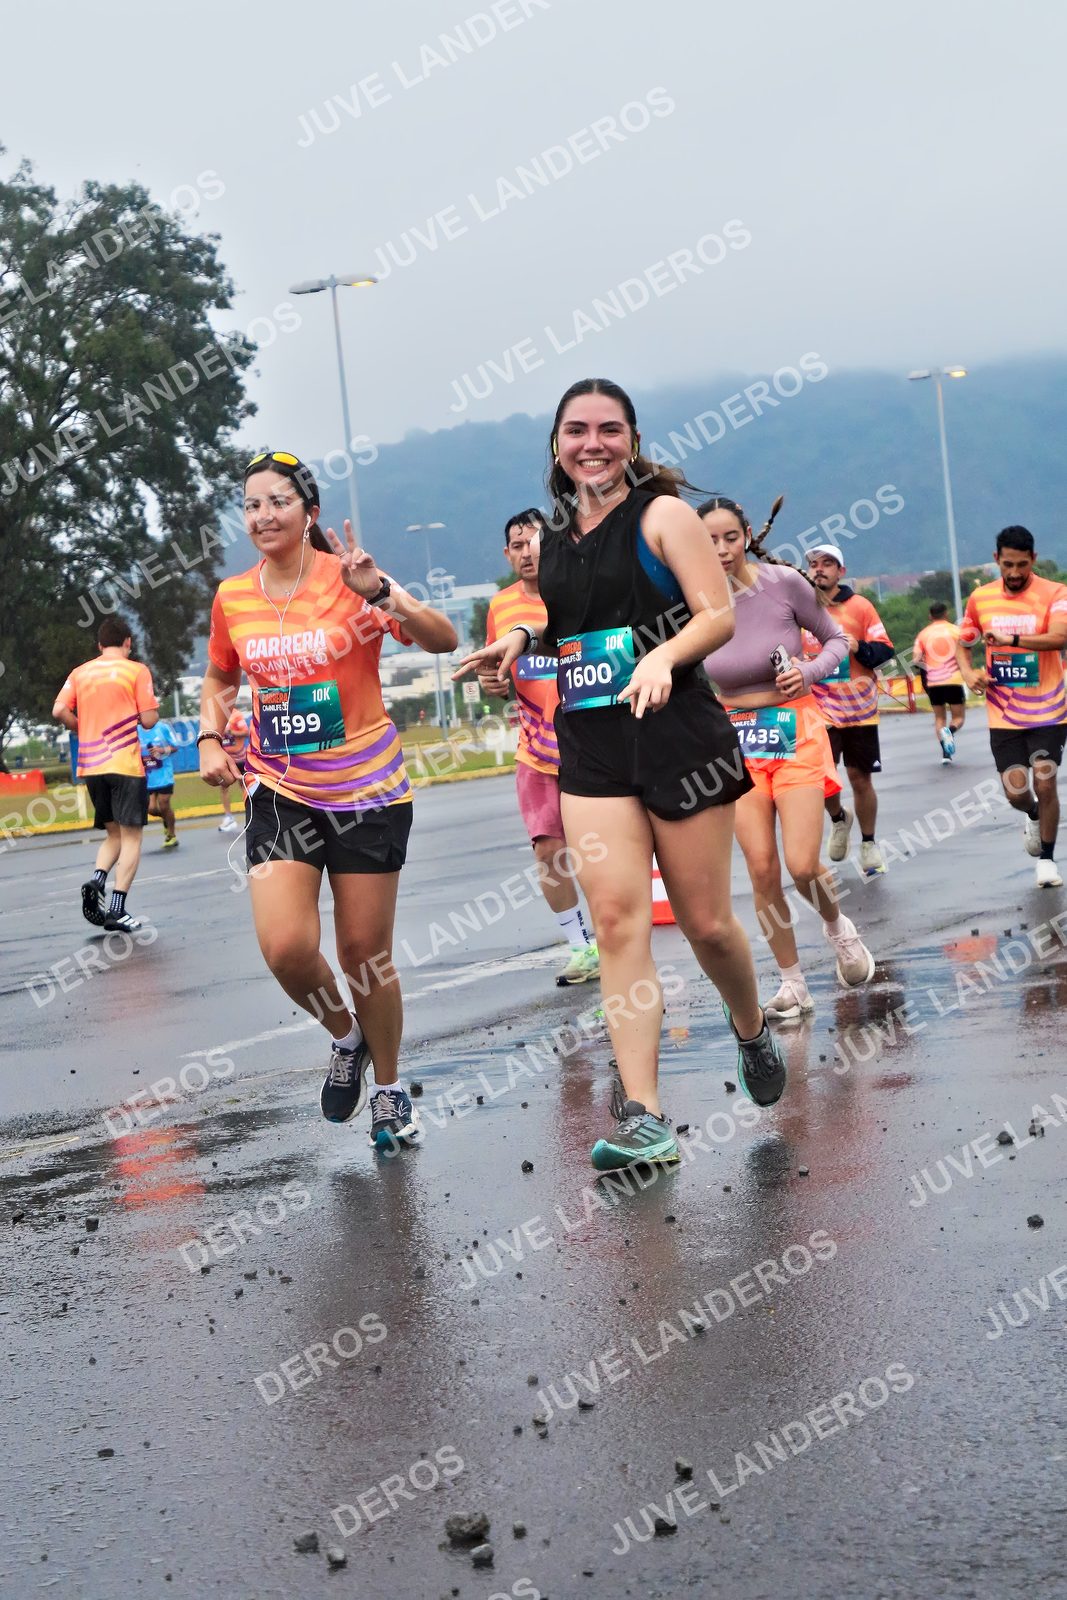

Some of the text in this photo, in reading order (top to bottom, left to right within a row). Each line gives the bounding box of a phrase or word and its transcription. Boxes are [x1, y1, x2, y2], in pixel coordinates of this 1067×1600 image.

[246, 628, 326, 659] CARRERA
[605, 633, 624, 651] 10K
[250, 655, 311, 673] OMNILIFE
[999, 667, 1027, 678] 1152
[565, 662, 612, 689] 1600
[312, 687, 330, 702] 10K
[272, 712, 321, 735] 1599
[730, 711, 791, 722] CARRERA 10K
[738, 728, 779, 744] 1435
